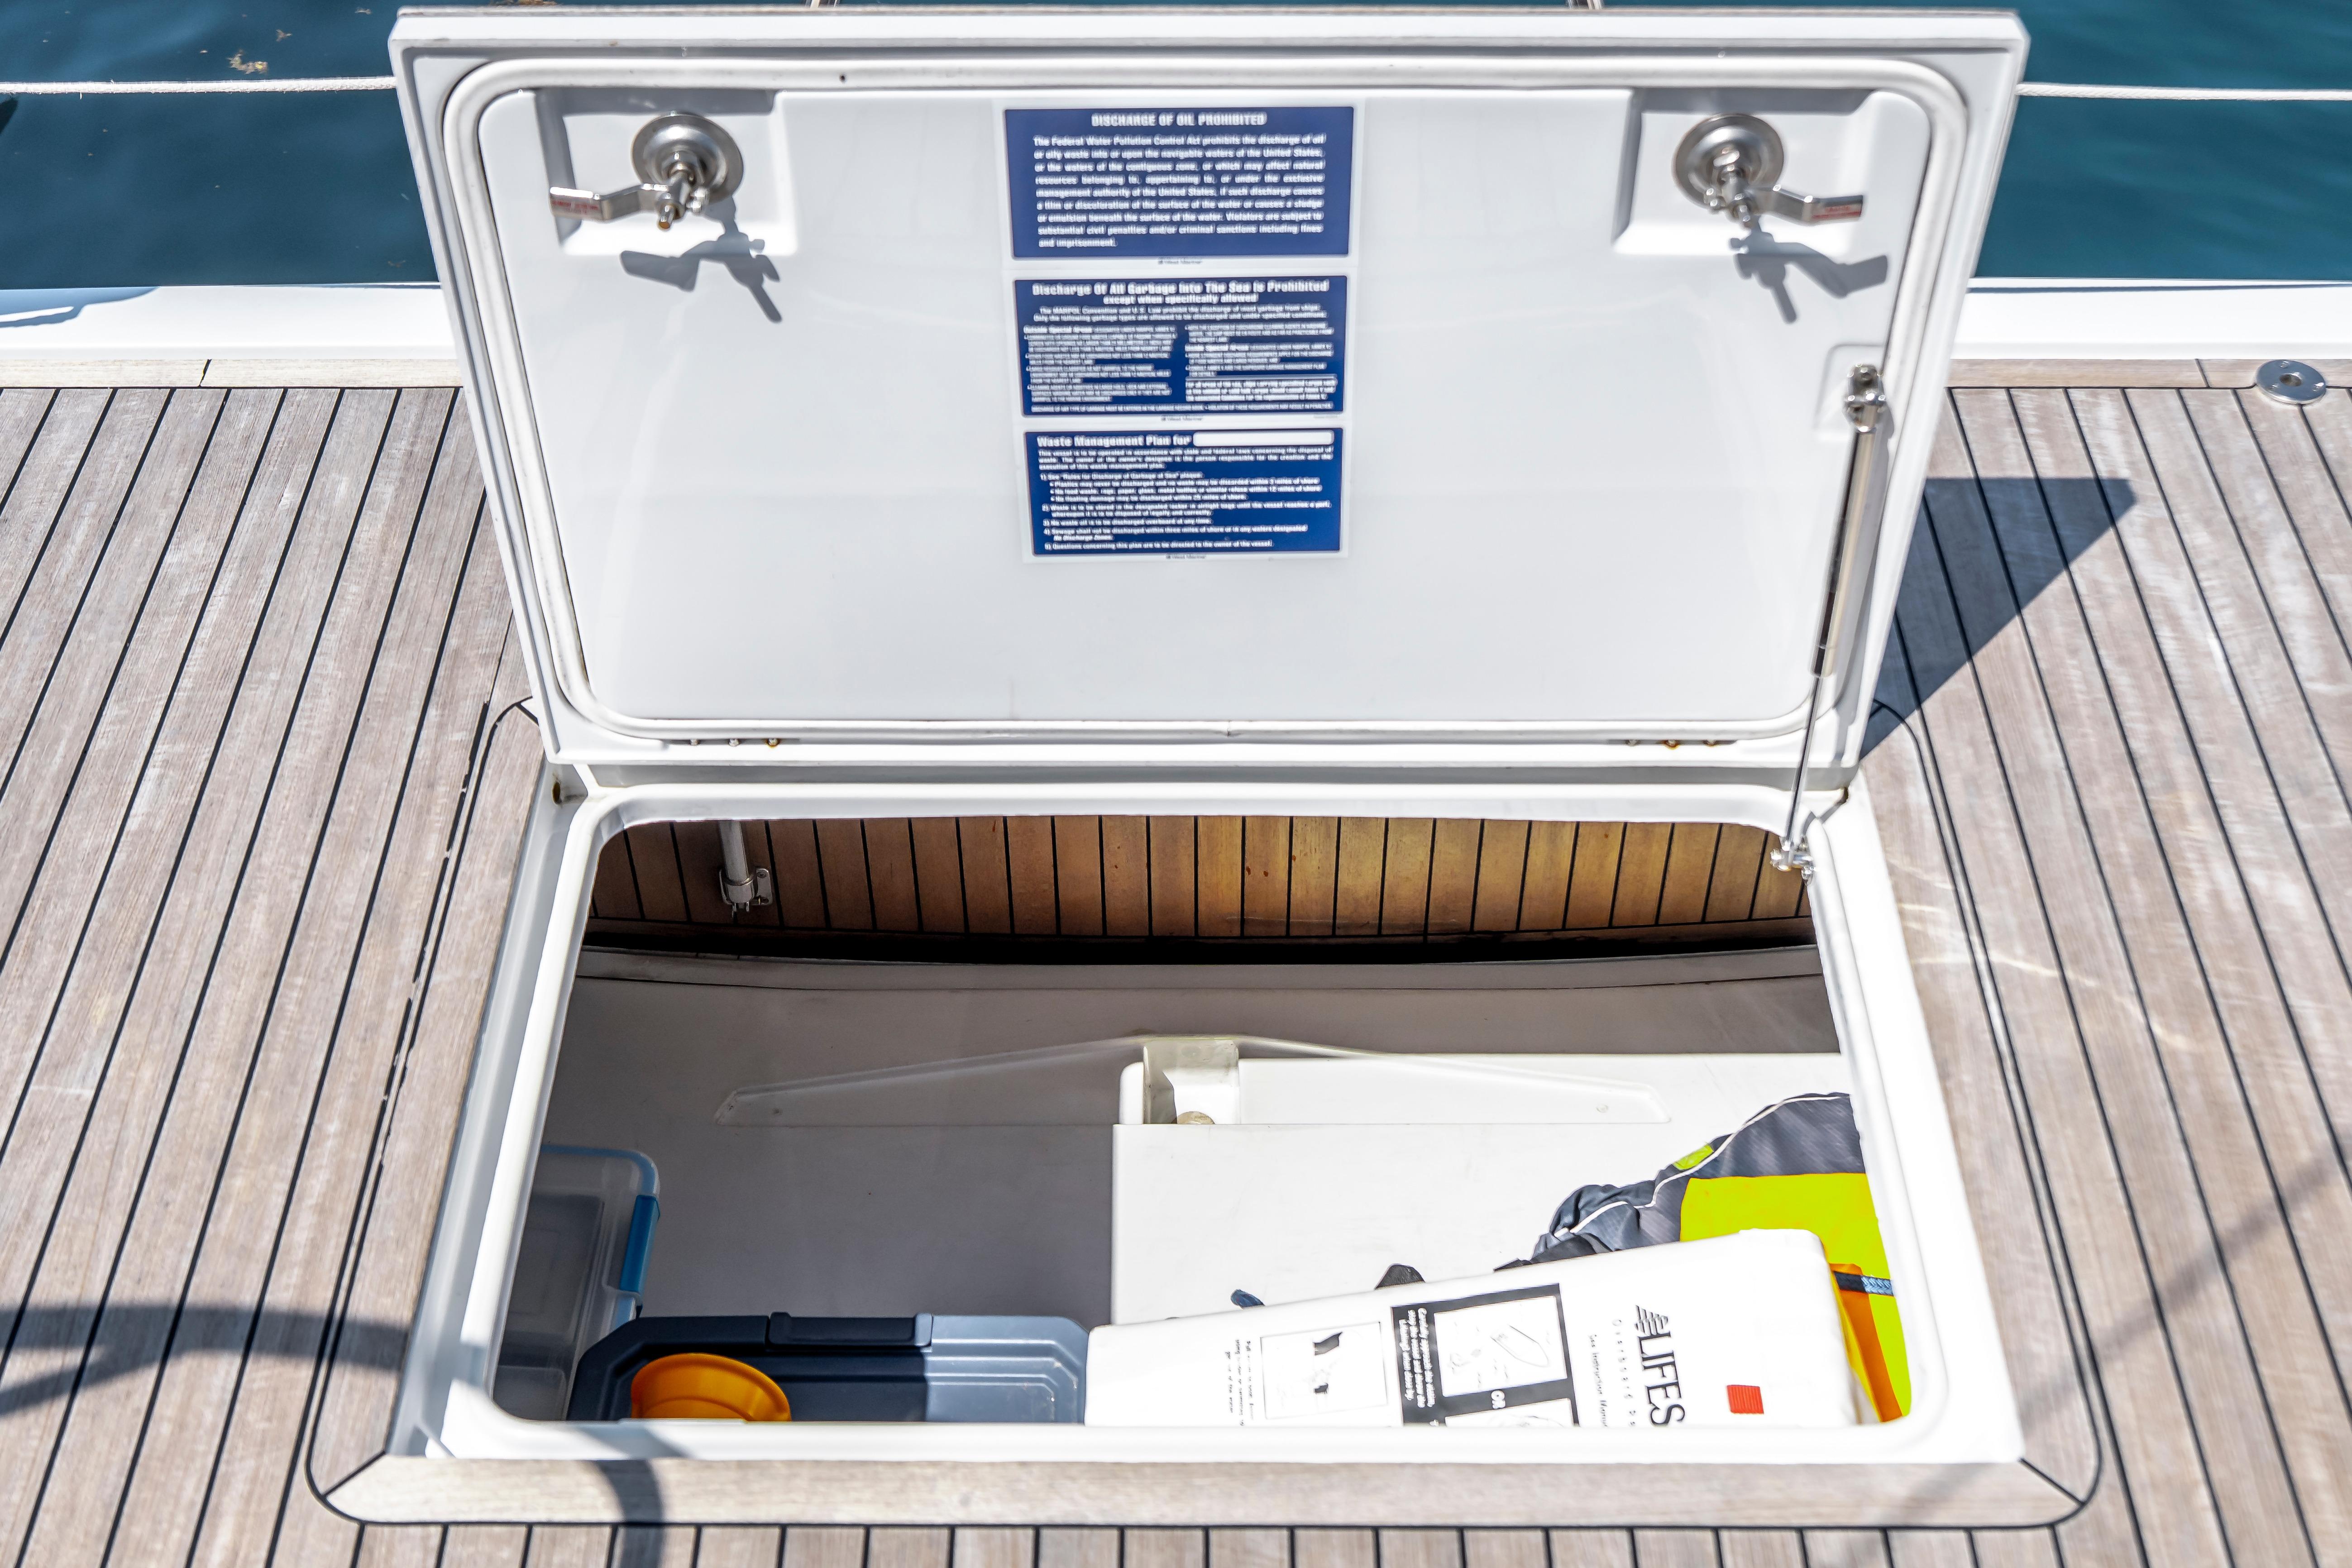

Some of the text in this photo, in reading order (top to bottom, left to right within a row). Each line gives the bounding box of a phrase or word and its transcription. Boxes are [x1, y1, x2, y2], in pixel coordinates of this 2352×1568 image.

[1091, 111, 1267, 127] DISCHARGE OF OIL PROHIBITED
[1033, 134, 1327, 146] The Federal Water Pollution Control Act prohibits the discharge of oil
[1033, 150, 1045, 159] or
[1045, 149, 1063, 160] oily
[1063, 149, 1091, 159] waste
[1090, 149, 1110, 158] into
[1109, 150, 1121, 158] or
[1121, 150, 1143, 159] upon
[1144, 148, 1161, 158] the
[1160, 148, 1204, 159] navigable
[1205, 148, 1235, 158] waters
[1235, 148, 1246, 158] of
[1246, 148, 1262, 158] the
[1262, 147, 1292, 158] United
[1034, 163, 1046, 172] or
[1047, 162, 1063, 172] the
[1064, 162, 1095, 172] waters
[1096, 162, 1108, 172] of
[1108, 162, 1125, 171] the
[1125, 162, 1174, 172] contiguous
[1202, 162, 1214, 171] or
[1214, 161, 1243, 171] which
[1243, 162, 1264, 171] may
[1265, 160, 1292, 170] affect
[1292, 160, 1326, 170] natural
[1035, 176, 1079, 185] resources
[1081, 174, 1126, 186] belonging
[1145, 174, 1201, 185] appertaining
[1220, 175, 1232, 183] or
[1234, 174, 1262, 183] under
[1264, 173, 1281, 183] the
[1282, 173, 1324, 183] exclusive
[1036, 188, 1093, 199] management
[1092, 187, 1132, 198] authority
[1131, 187, 1143, 197] of
[1142, 187, 1158, 197] the
[1157, 186, 1186, 196] United
[1219, 186, 1226, 196] if
[1228, 186, 1248, 196] such
[1249, 186, 1292, 197] discharge
[1292, 186, 1324, 195] causes
[1036, 198, 1324, 210] a film or discoloration of the surface of the water or causes a sludge
[1037, 214, 1048, 223] or
[1047, 213, 1087, 223] emulsion
[1088, 213, 1123, 222] beneath
[1123, 212, 1138, 222] the
[1139, 212, 1171, 222] surface
[1171, 212, 1181, 222] of
[1182, 212, 1196, 221] the
[1225, 211, 1264, 221] Violators
[1265, 212, 1280, 221] are
[1281, 211, 1312, 221] subject
[1312, 211, 1324, 220] to
[1037, 224, 1324, 235] substantial civil penalties and/or criminal sanctions including fines
[1038, 239, 1056, 248] and
[1032, 283, 1092, 296] Discharge
[1094, 283, 1108, 295] Of
[1109, 283, 1126, 294] All
[1127, 282, 1177, 294] Garbage
[1178, 282, 1203, 293] Into
[1205, 281, 1227, 293] The
[1229, 281, 1252, 292] Sea
[1267, 280, 1329, 292] Prohibited
[1103, 292, 1258, 305] except when specifically allowed
[1037, 435, 1191, 448] Waste Management Plan for
[1418, 1308, 1429, 1339] Carefully
[1409, 1325, 1419, 1338] the
[1411, 1338, 1421, 1359] vessel
[1420, 1339, 1433, 1370] approach
[1402, 1351, 1411, 1370] when
[1413, 1359, 1423, 1373] and
[1404, 1371, 1413, 1389] close
[1425, 1370, 1433, 1383] the
[1637, 1331, 1685, 1426] LIFES
[1415, 1373, 1425, 1395] throw
[1416, 1395, 1426, 1408] the
[1491, 1390, 1506, 1409] OR
